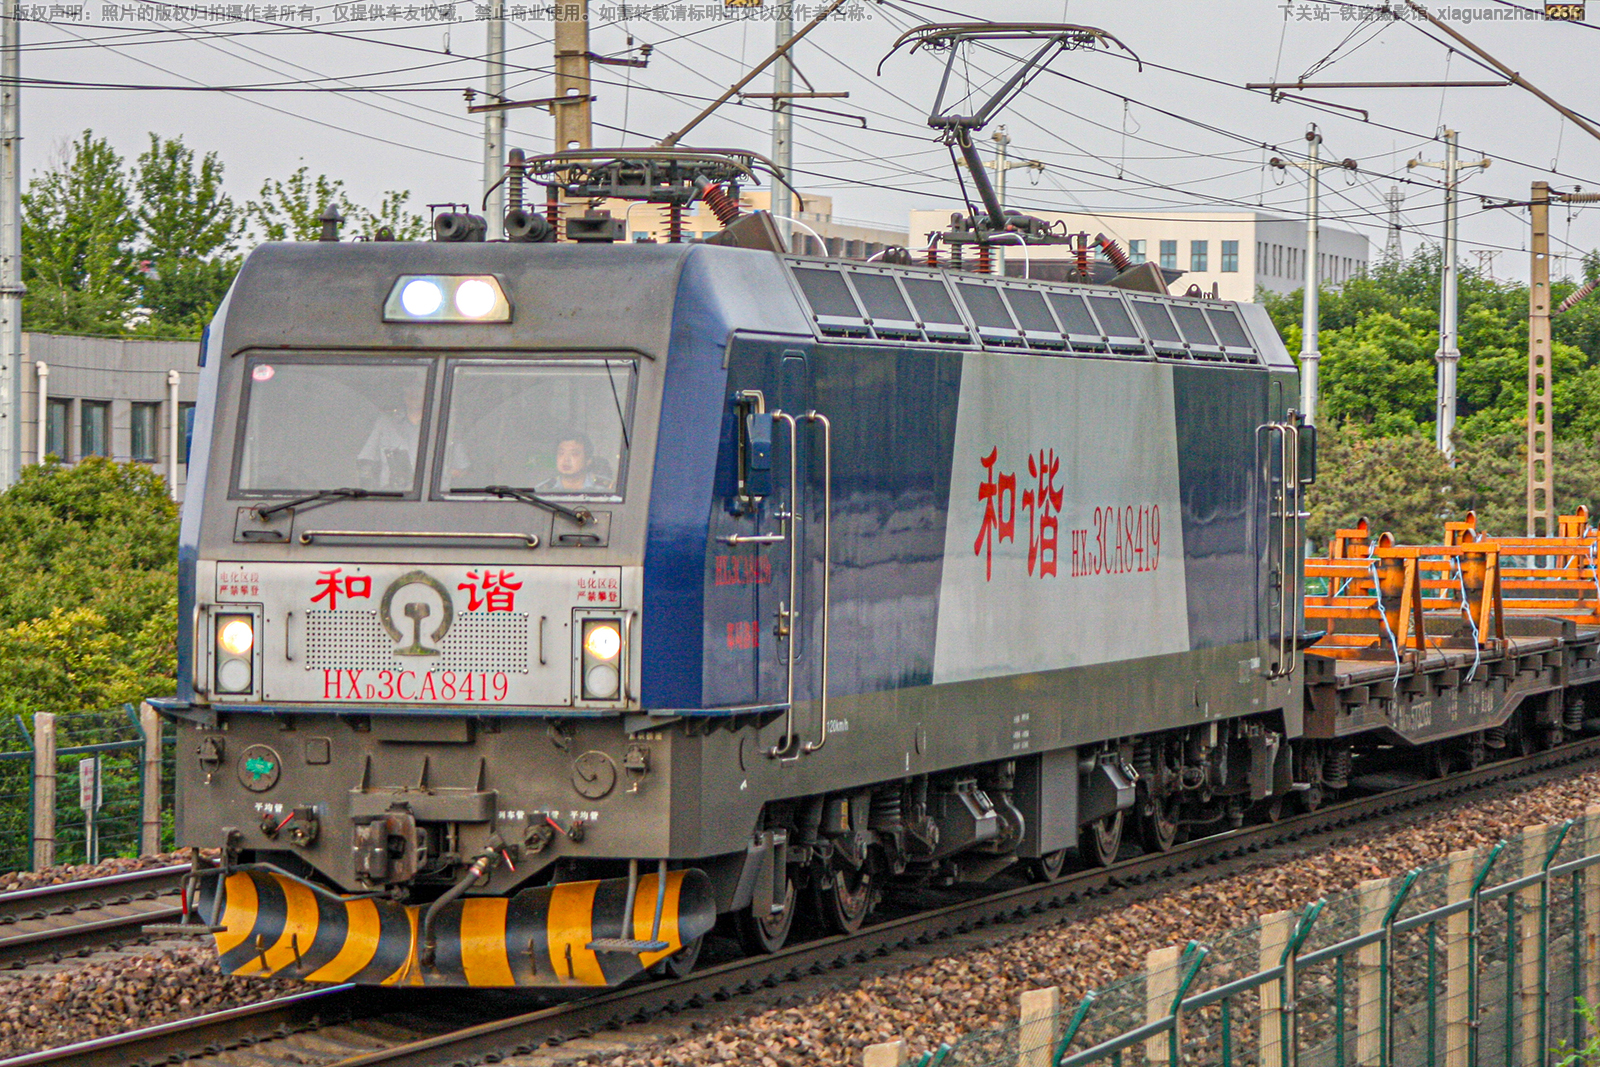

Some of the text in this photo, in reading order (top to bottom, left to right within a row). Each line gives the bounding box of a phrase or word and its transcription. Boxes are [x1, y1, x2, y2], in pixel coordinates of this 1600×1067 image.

[974, 446, 1064, 581] 和谐
[219, 571, 260, 583] 电化区段
[577, 577, 618, 590] 电化区段
